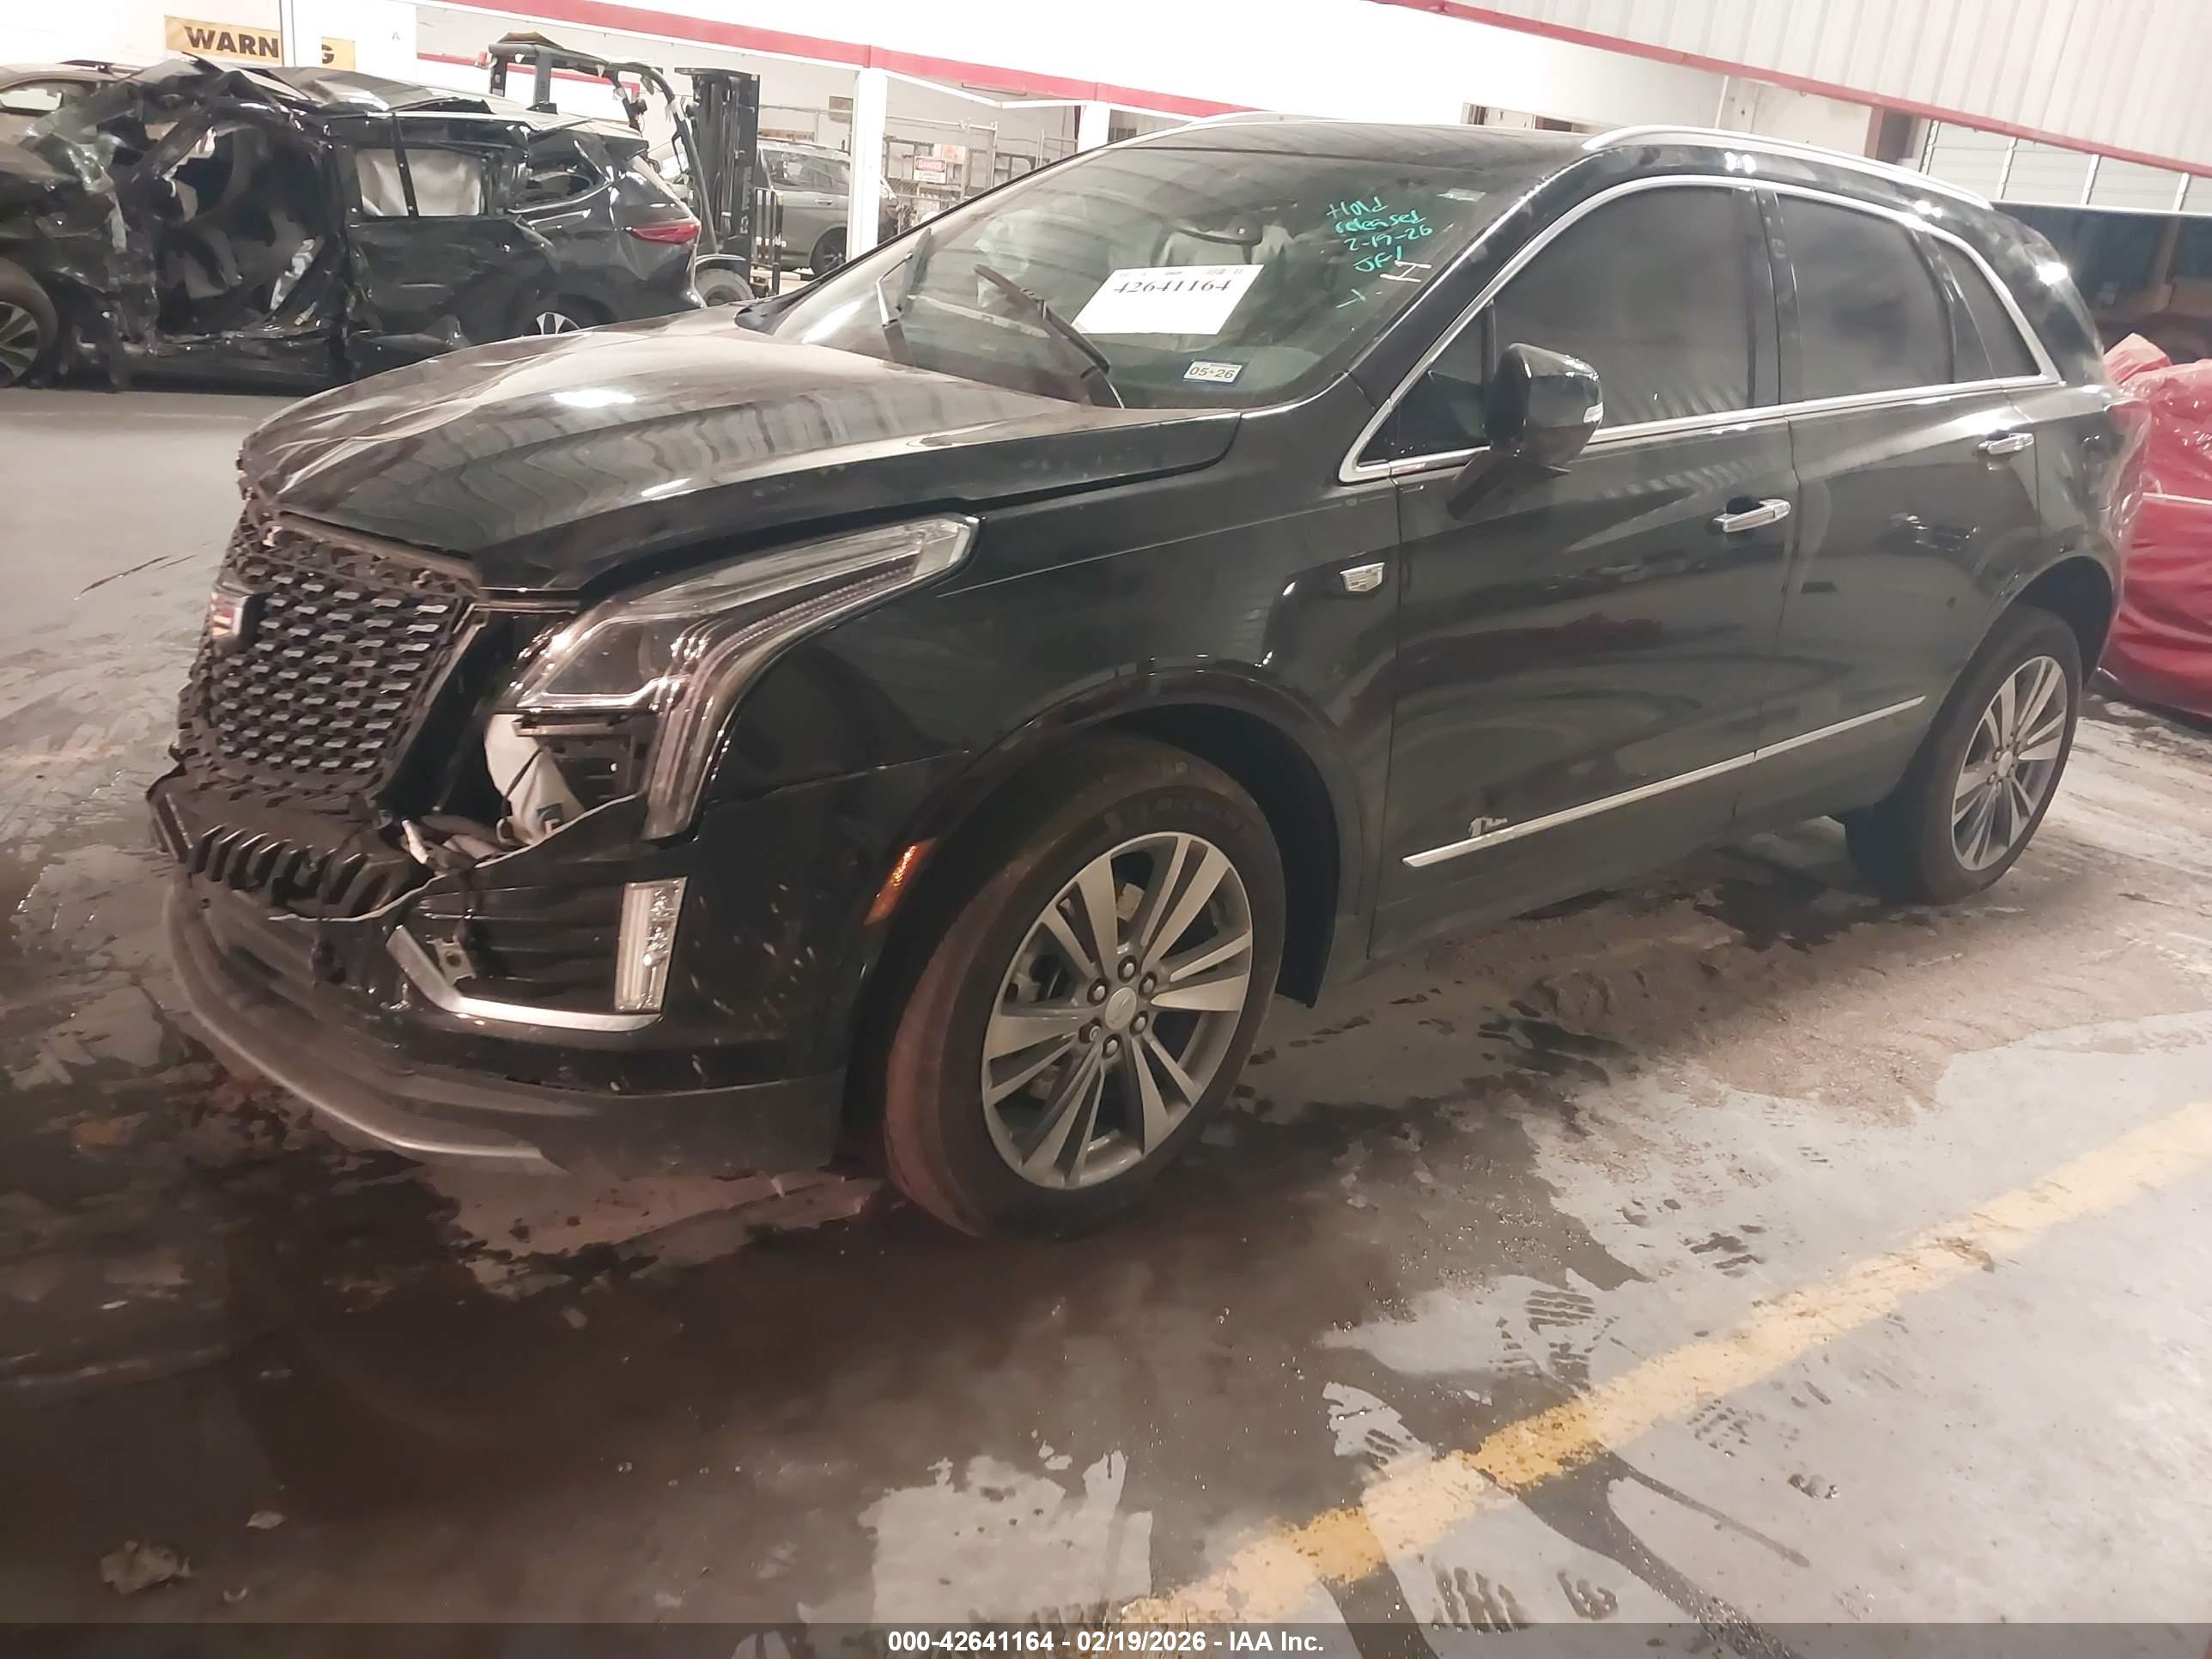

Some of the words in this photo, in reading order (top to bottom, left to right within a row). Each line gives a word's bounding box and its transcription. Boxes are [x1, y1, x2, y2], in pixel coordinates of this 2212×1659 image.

[185, 26, 335, 64] WARNG
[1343, 224, 1433, 251] 2-19-26
[1114, 279, 1231, 294] 42641164
